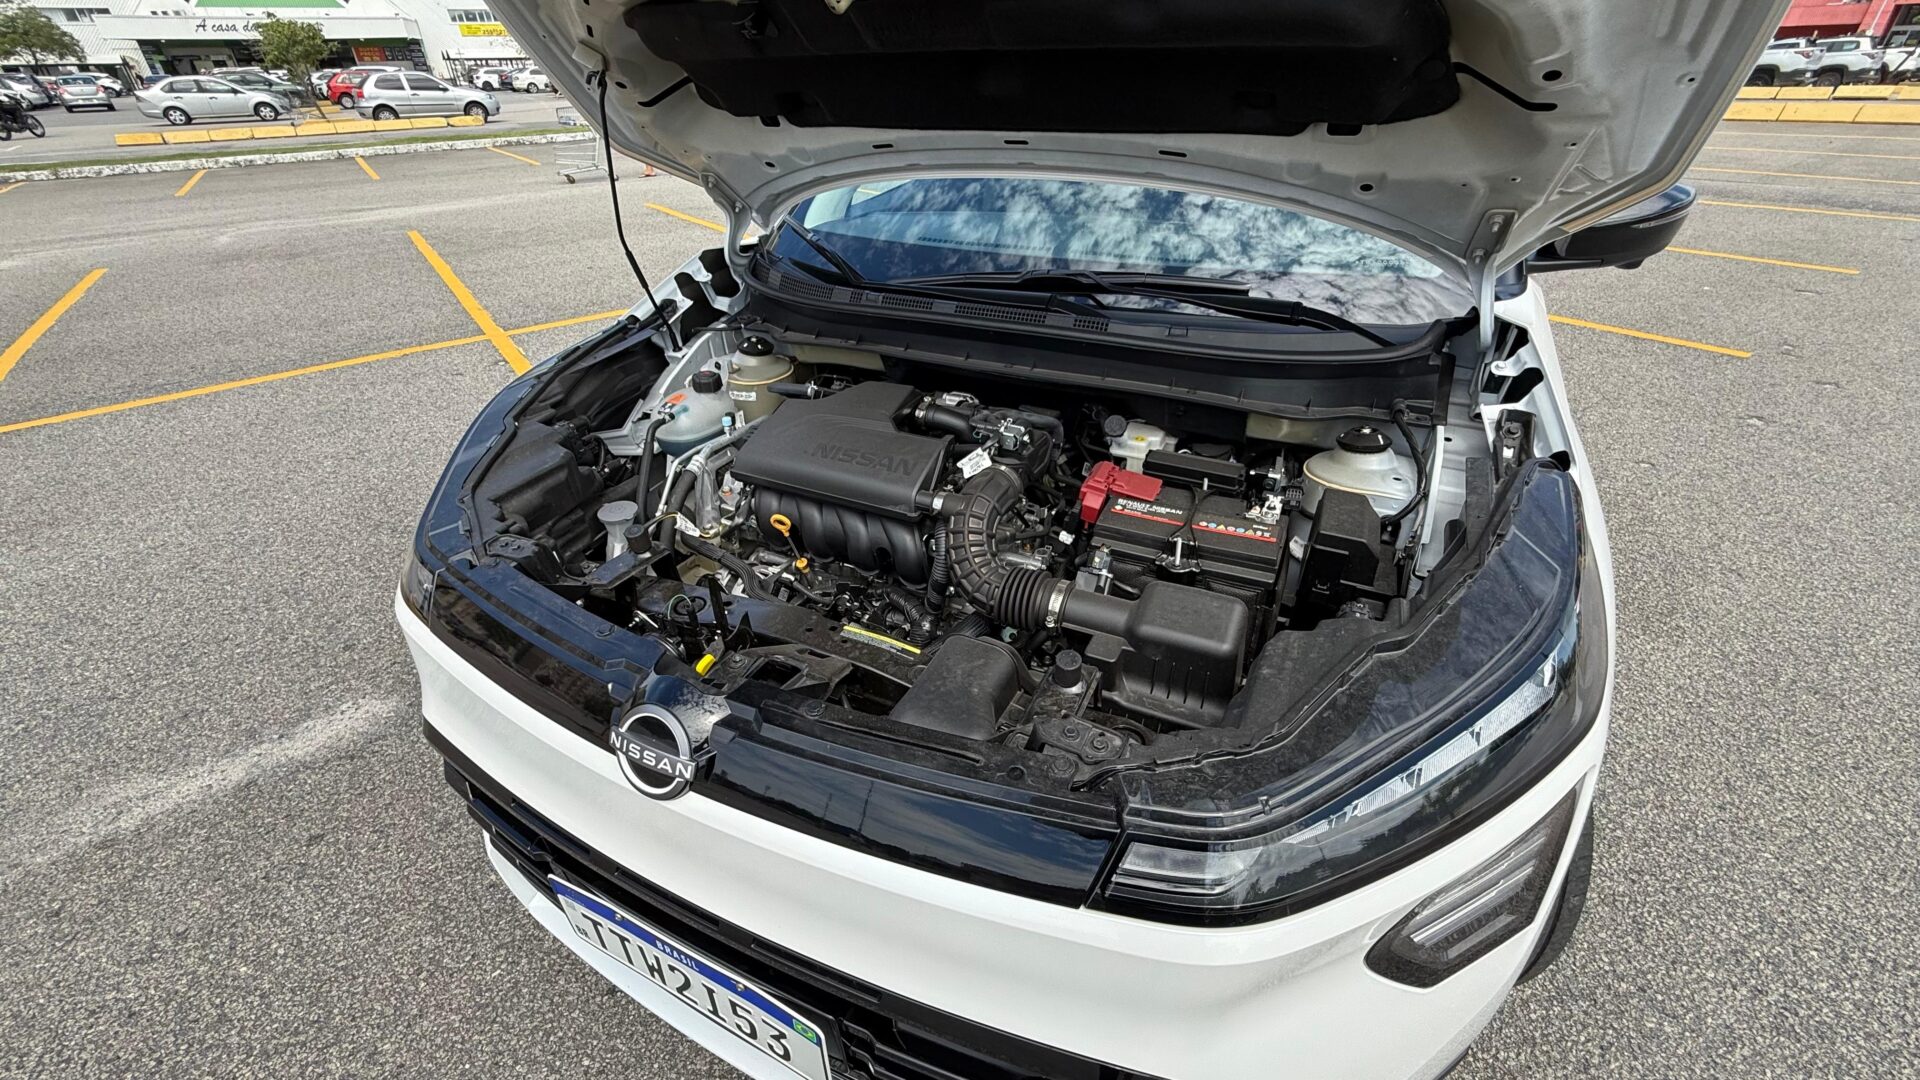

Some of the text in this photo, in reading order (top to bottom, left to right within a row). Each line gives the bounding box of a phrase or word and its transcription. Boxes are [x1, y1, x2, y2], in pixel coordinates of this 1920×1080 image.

[195, 18, 207, 32] A
[211, 24, 239, 32] casa
[811, 443, 919, 476] NISSAN
[1117, 498, 1150, 510] RENAULT
[610, 731, 692, 779] NISSAN
[655, 939, 700, 972] BRASIL
[580, 911, 792, 1062] TTW2I53
